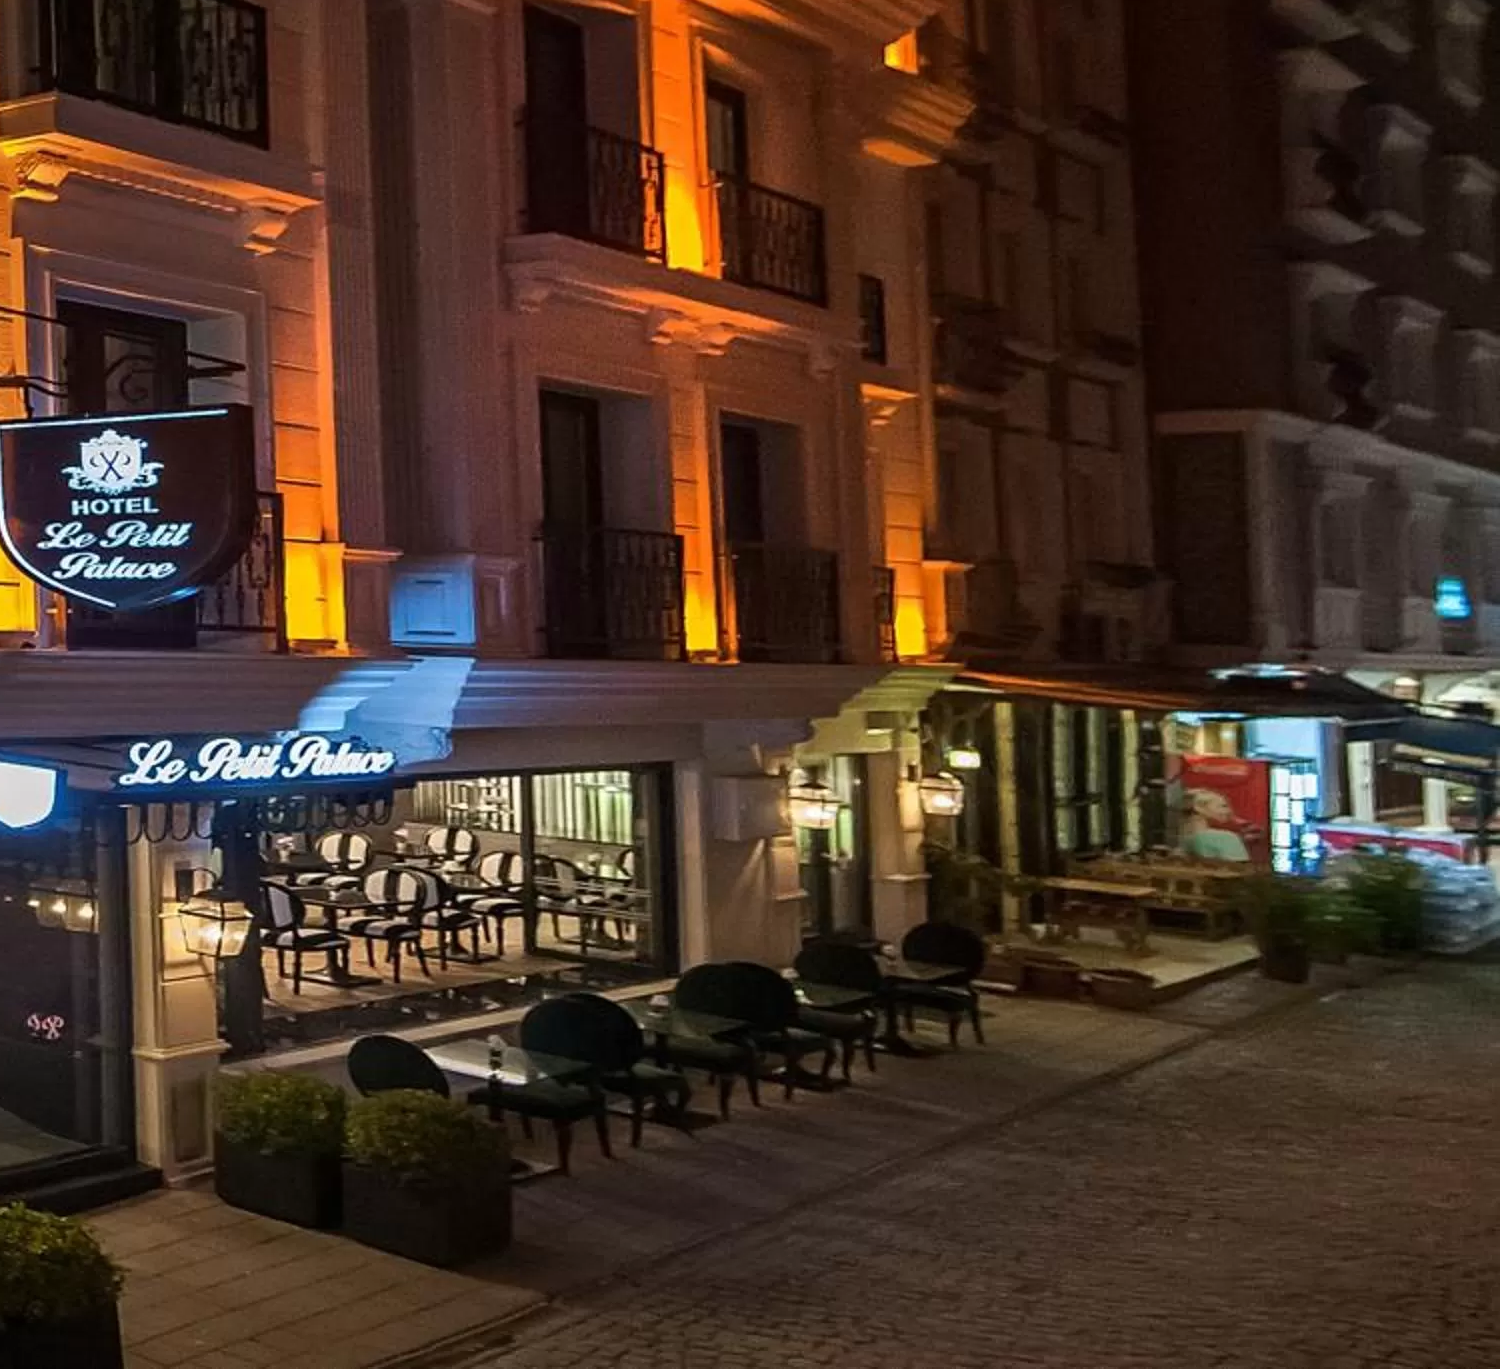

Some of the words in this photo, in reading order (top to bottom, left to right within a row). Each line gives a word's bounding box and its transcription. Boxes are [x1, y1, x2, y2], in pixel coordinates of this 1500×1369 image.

[71, 498, 160, 516] HOTEL
[36, 520, 98, 549] Le
[100, 520, 193, 548] Petit
[52, 552, 177, 579] Palace
[119, 739, 189, 786] Le
[189, 737, 284, 782] Petit
[281, 735, 397, 778] Palace
